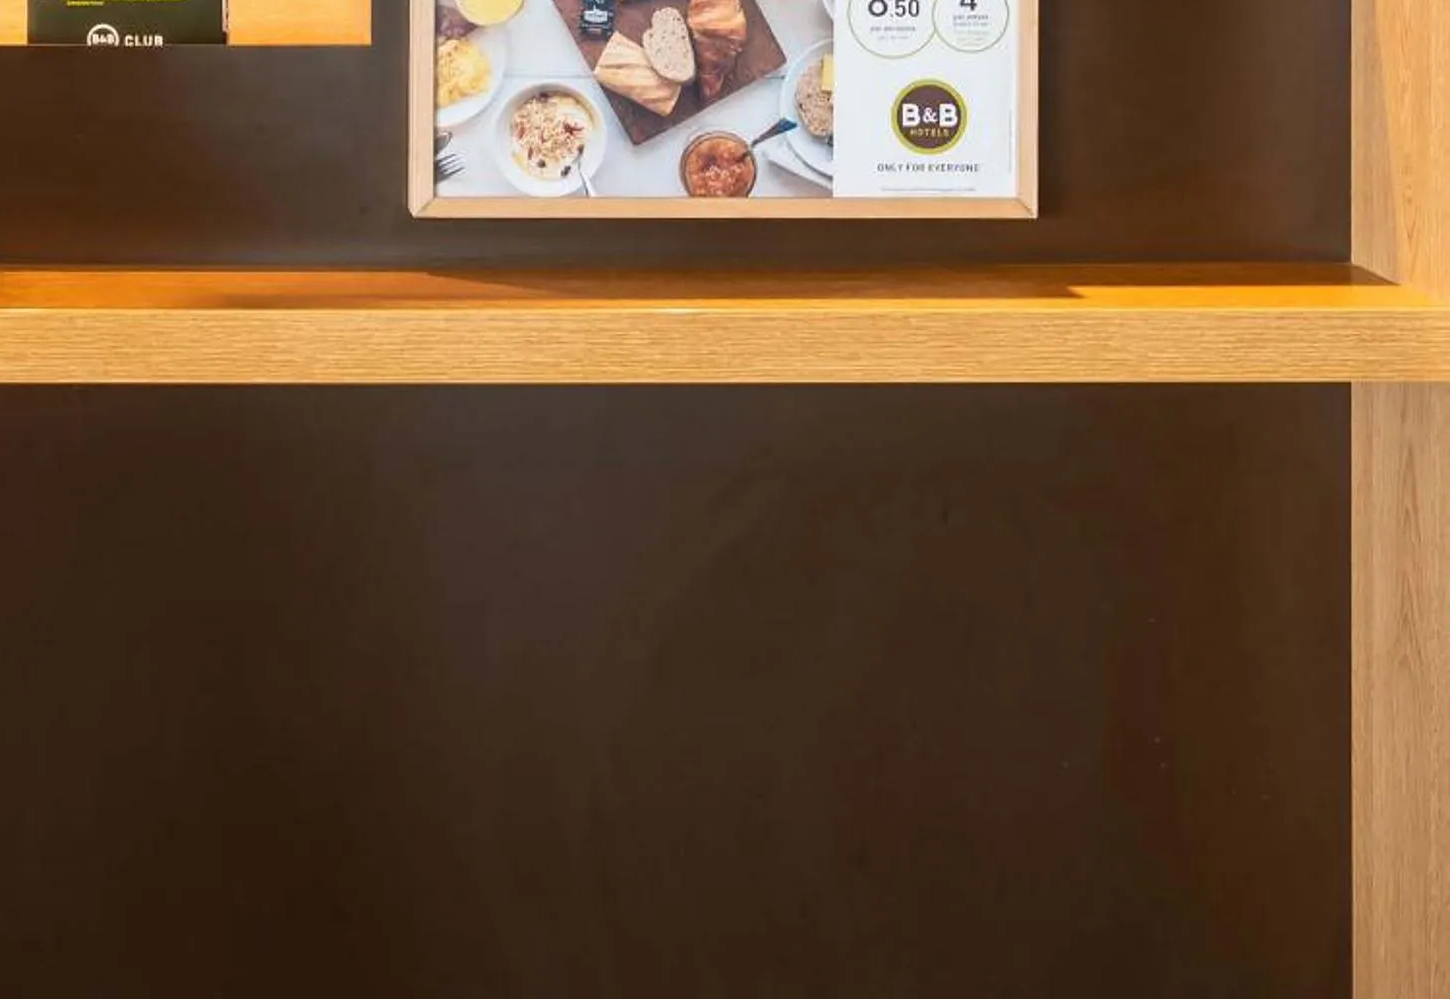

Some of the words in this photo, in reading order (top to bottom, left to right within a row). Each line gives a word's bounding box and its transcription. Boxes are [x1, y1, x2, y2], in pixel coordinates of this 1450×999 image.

[124, 34, 164, 46] CLUB
[901, 103, 958, 127] B&B
[909, 128, 949, 137] HOTELS
